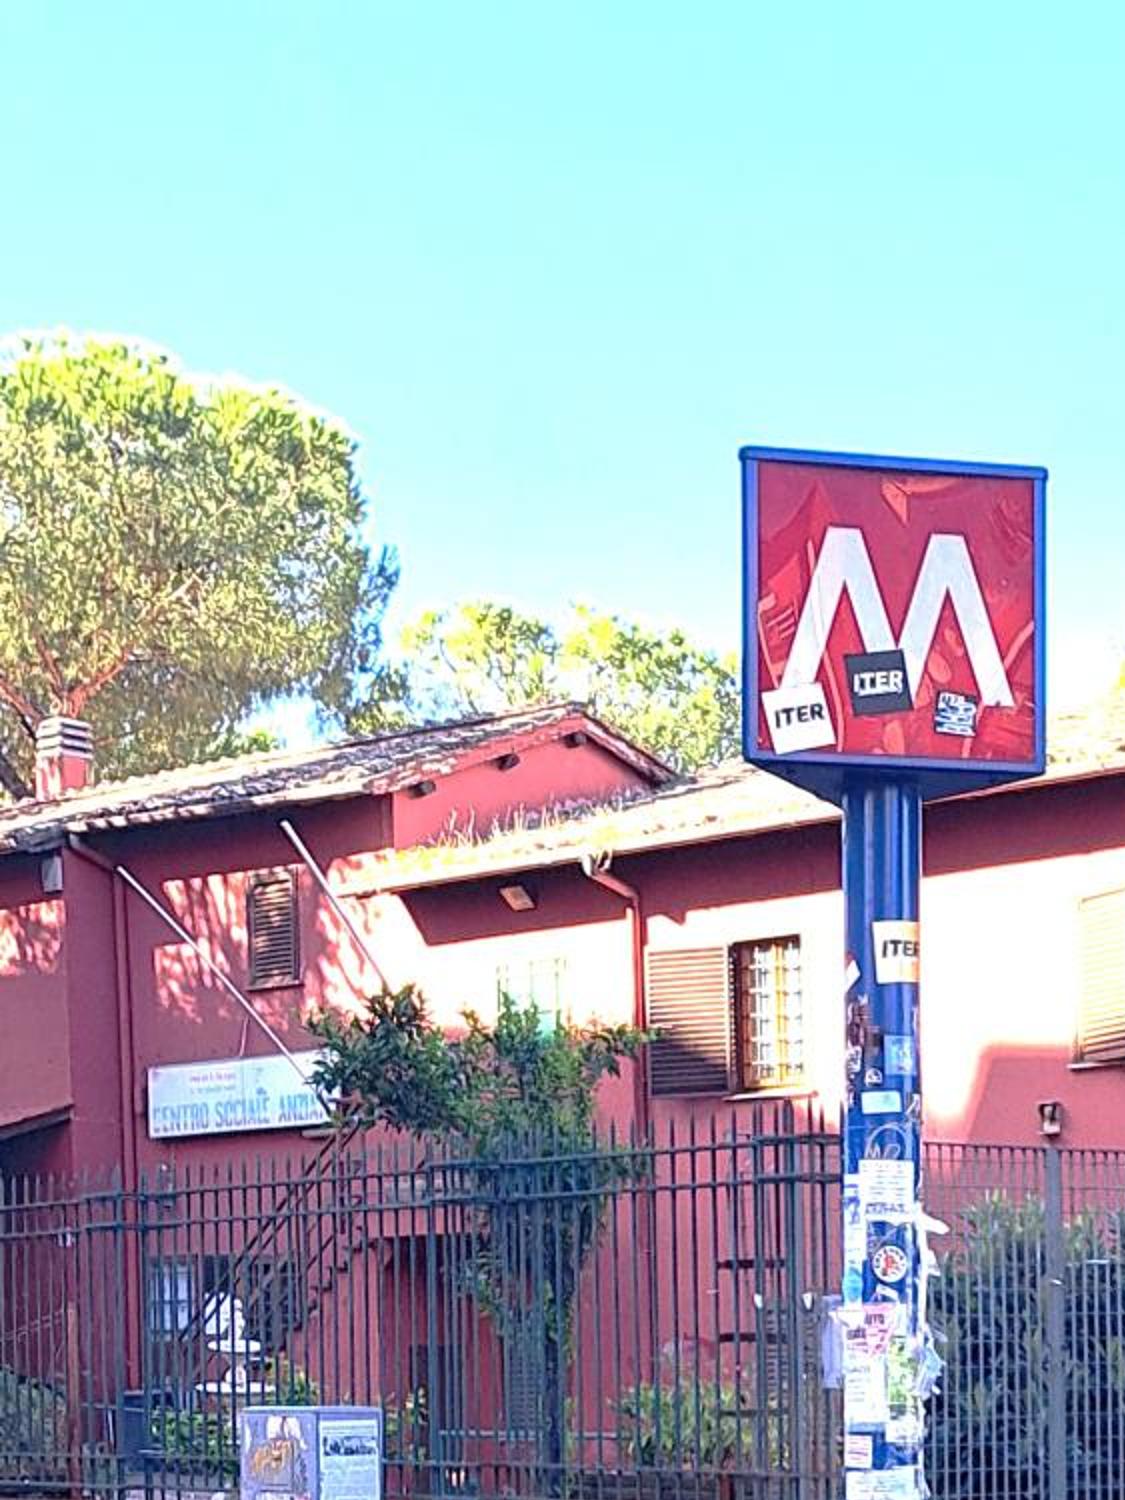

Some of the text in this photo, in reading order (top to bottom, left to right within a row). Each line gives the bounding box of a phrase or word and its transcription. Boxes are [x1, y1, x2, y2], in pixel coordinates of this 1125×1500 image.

[781, 525, 1016, 707] M
[853, 671, 904, 695] ITER
[774, 703, 825, 729] ITER
[153, 1093, 324, 1133] CENTRO SOCIALE ANZIA
